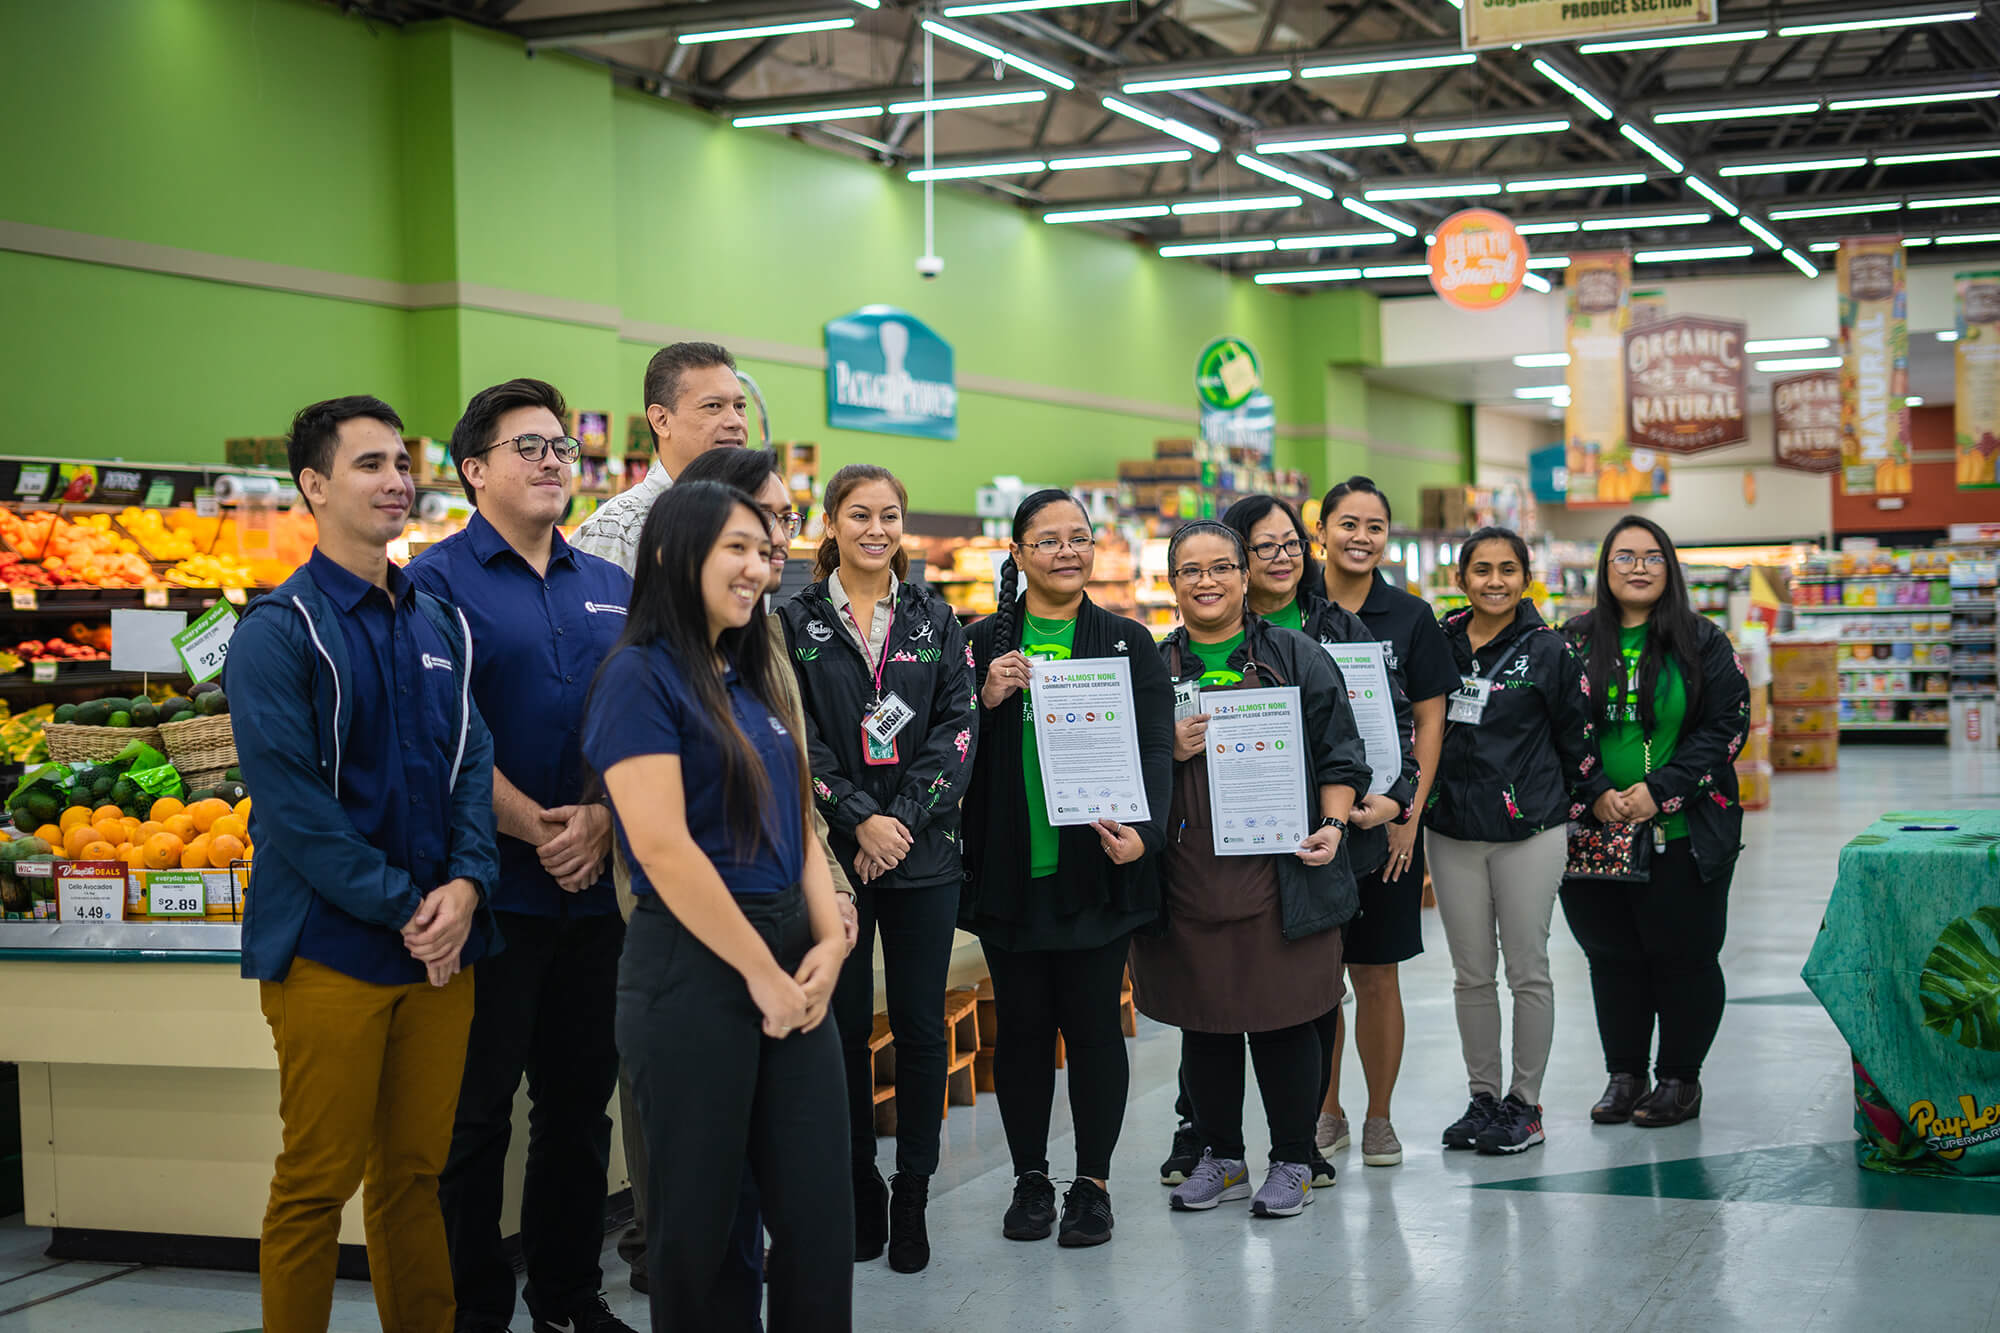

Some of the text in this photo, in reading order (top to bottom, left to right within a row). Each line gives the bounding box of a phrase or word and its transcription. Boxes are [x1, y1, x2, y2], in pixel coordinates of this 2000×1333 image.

[1562, 0, 1692, 20] PRODUCE SECTION
[1628, 328, 1741, 373] ORGANIC
[1859, 312, 1888, 459] NATURAL
[1775, 382, 1841, 412] ORGAN
[1632, 392, 1741, 434] NATURAL
[200, 642, 229, 666] $2.9
[1097, 672, 1116, 681] NONE
[1268, 702, 1287, 710] NONE
[95, 868, 121, 876] DEALS
[158, 898, 197, 911] $2.89
